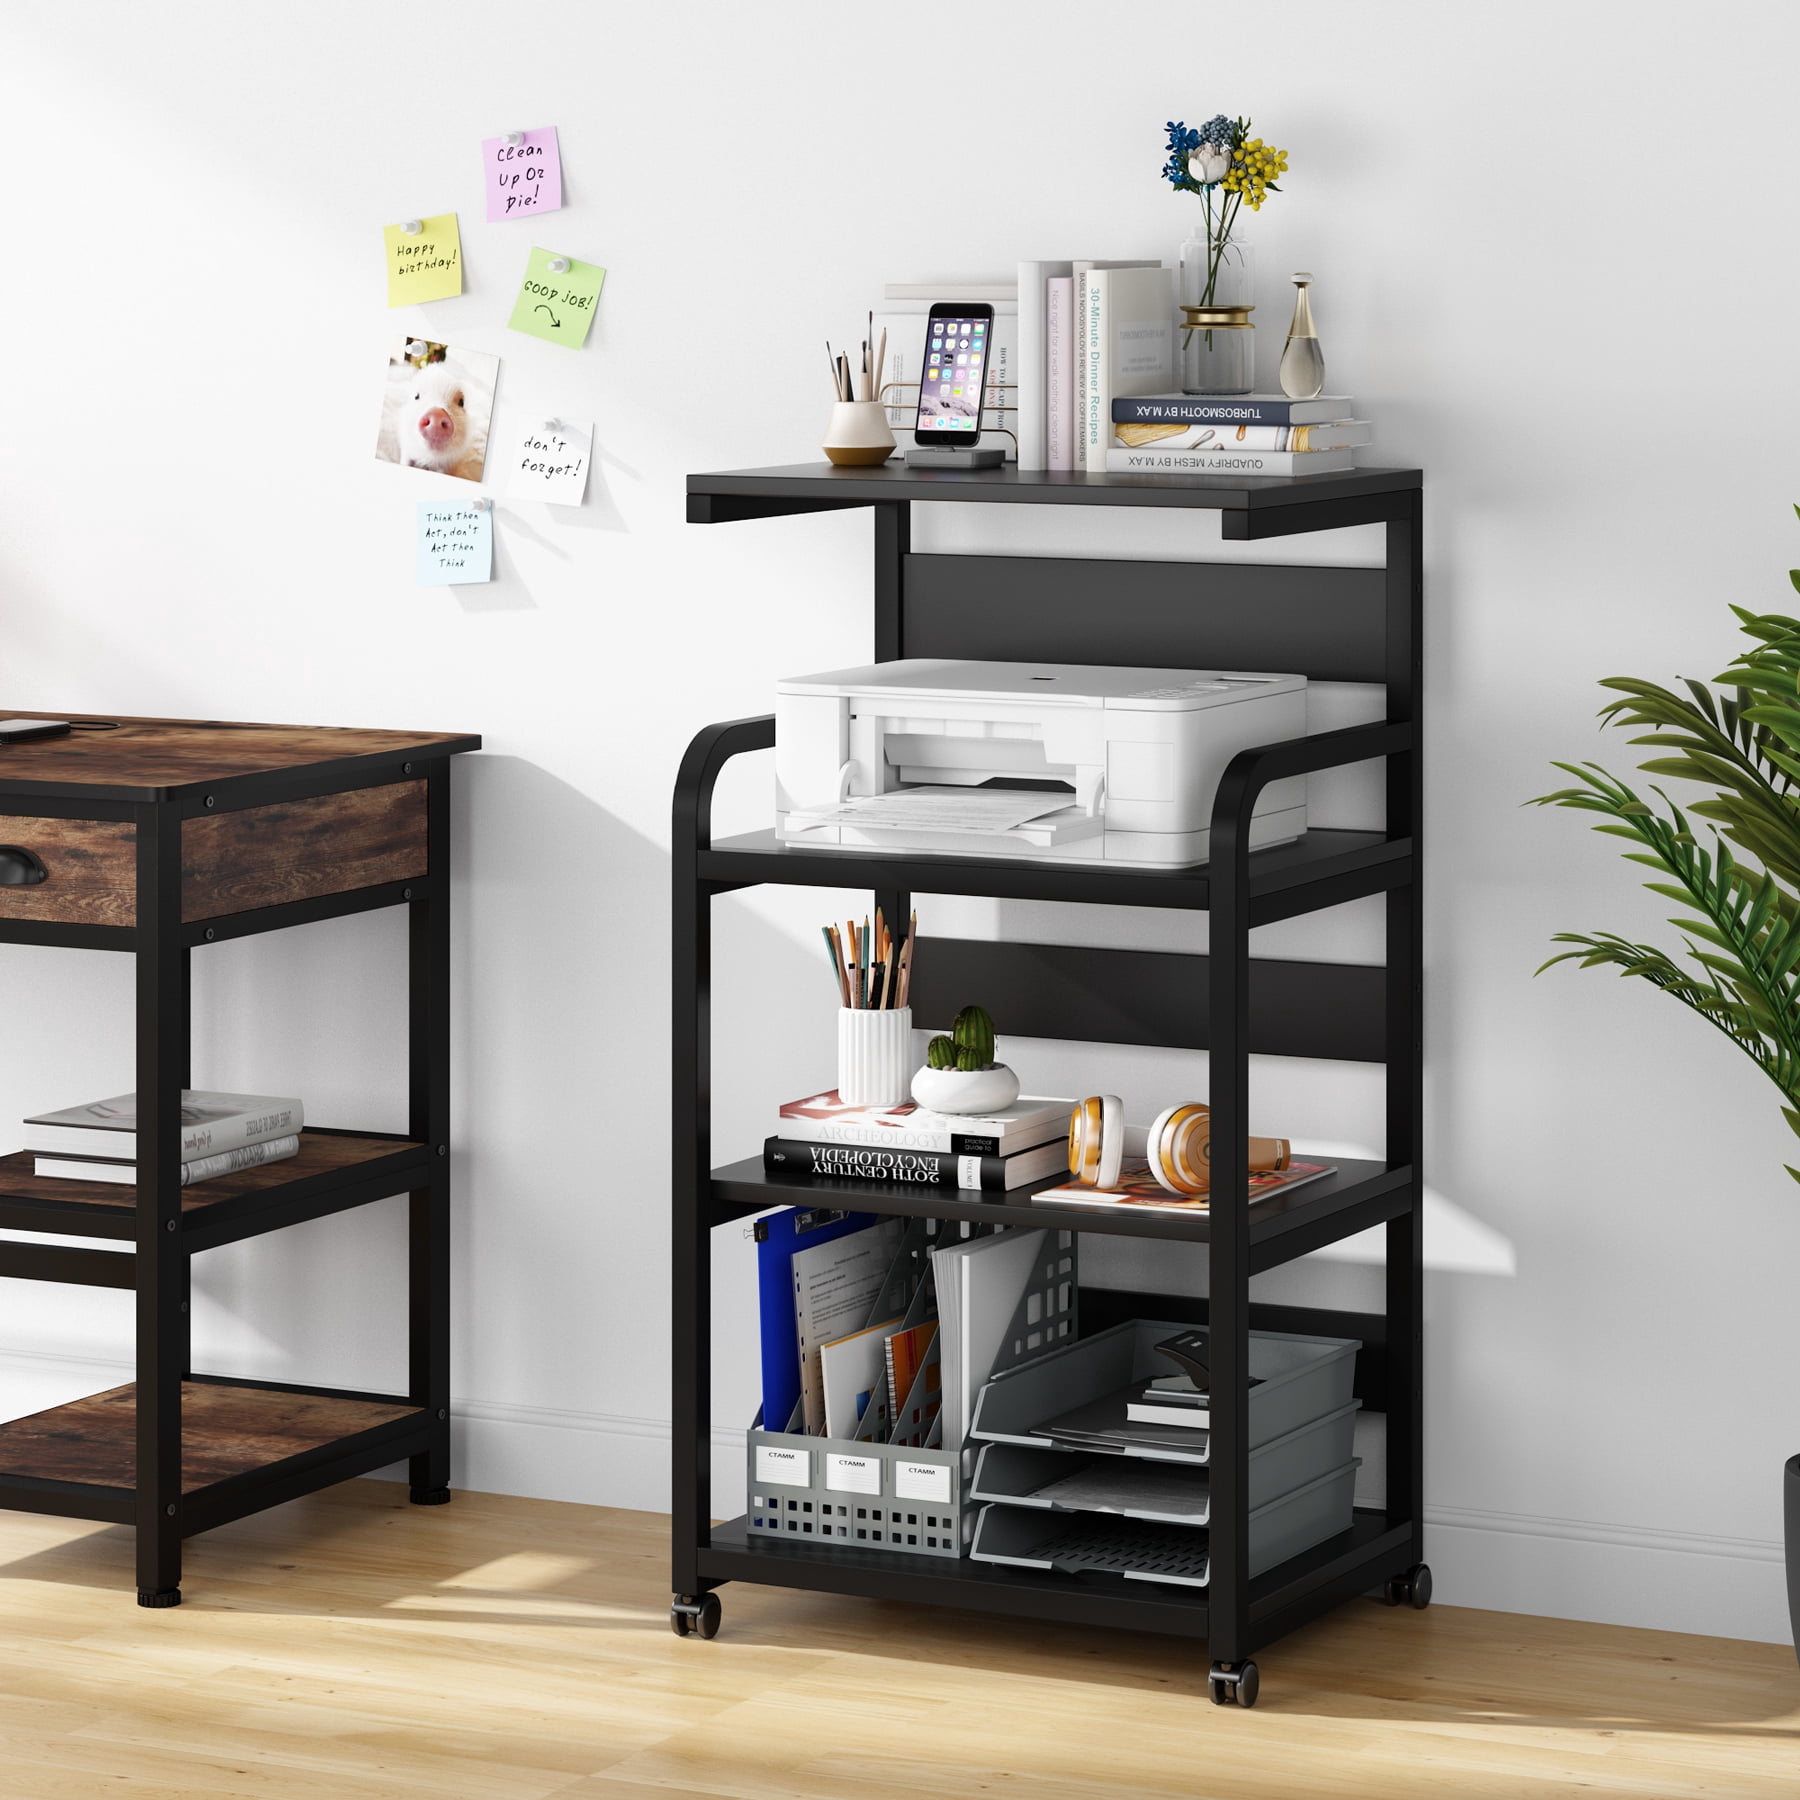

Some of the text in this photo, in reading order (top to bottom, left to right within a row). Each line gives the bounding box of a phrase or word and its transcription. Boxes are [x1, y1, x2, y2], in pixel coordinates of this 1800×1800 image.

[497, 146, 543, 162] Clean
[499, 173, 520, 189] Up
[397, 243, 435, 258] Happy
[398, 249, 457, 275] birthday!
[1089, 288, 1100, 445] 30-Minute Dinner Recipes
[1079, 389, 1086, 400] OF
[1136, 406, 1262, 418] TURBOSMOOTH BY M.AX
[524, 436, 567, 453] don't
[521, 459, 582, 480] forget!
[1128, 456, 1263, 469] QUADRIFY MESH BY M.AX
[426, 513, 453, 523] Think
[449, 524, 479, 536] don't
[439, 558, 466, 568] Think
[817, 1126, 943, 1149] ARCHEOLOGY
[964, 1138, 992, 1146] practical
[964, 1144, 984, 1152] guide
[809, 1146, 940, 1172] ENCYCLOPEDIA
[812, 1161, 887, 1179] CENTURY
